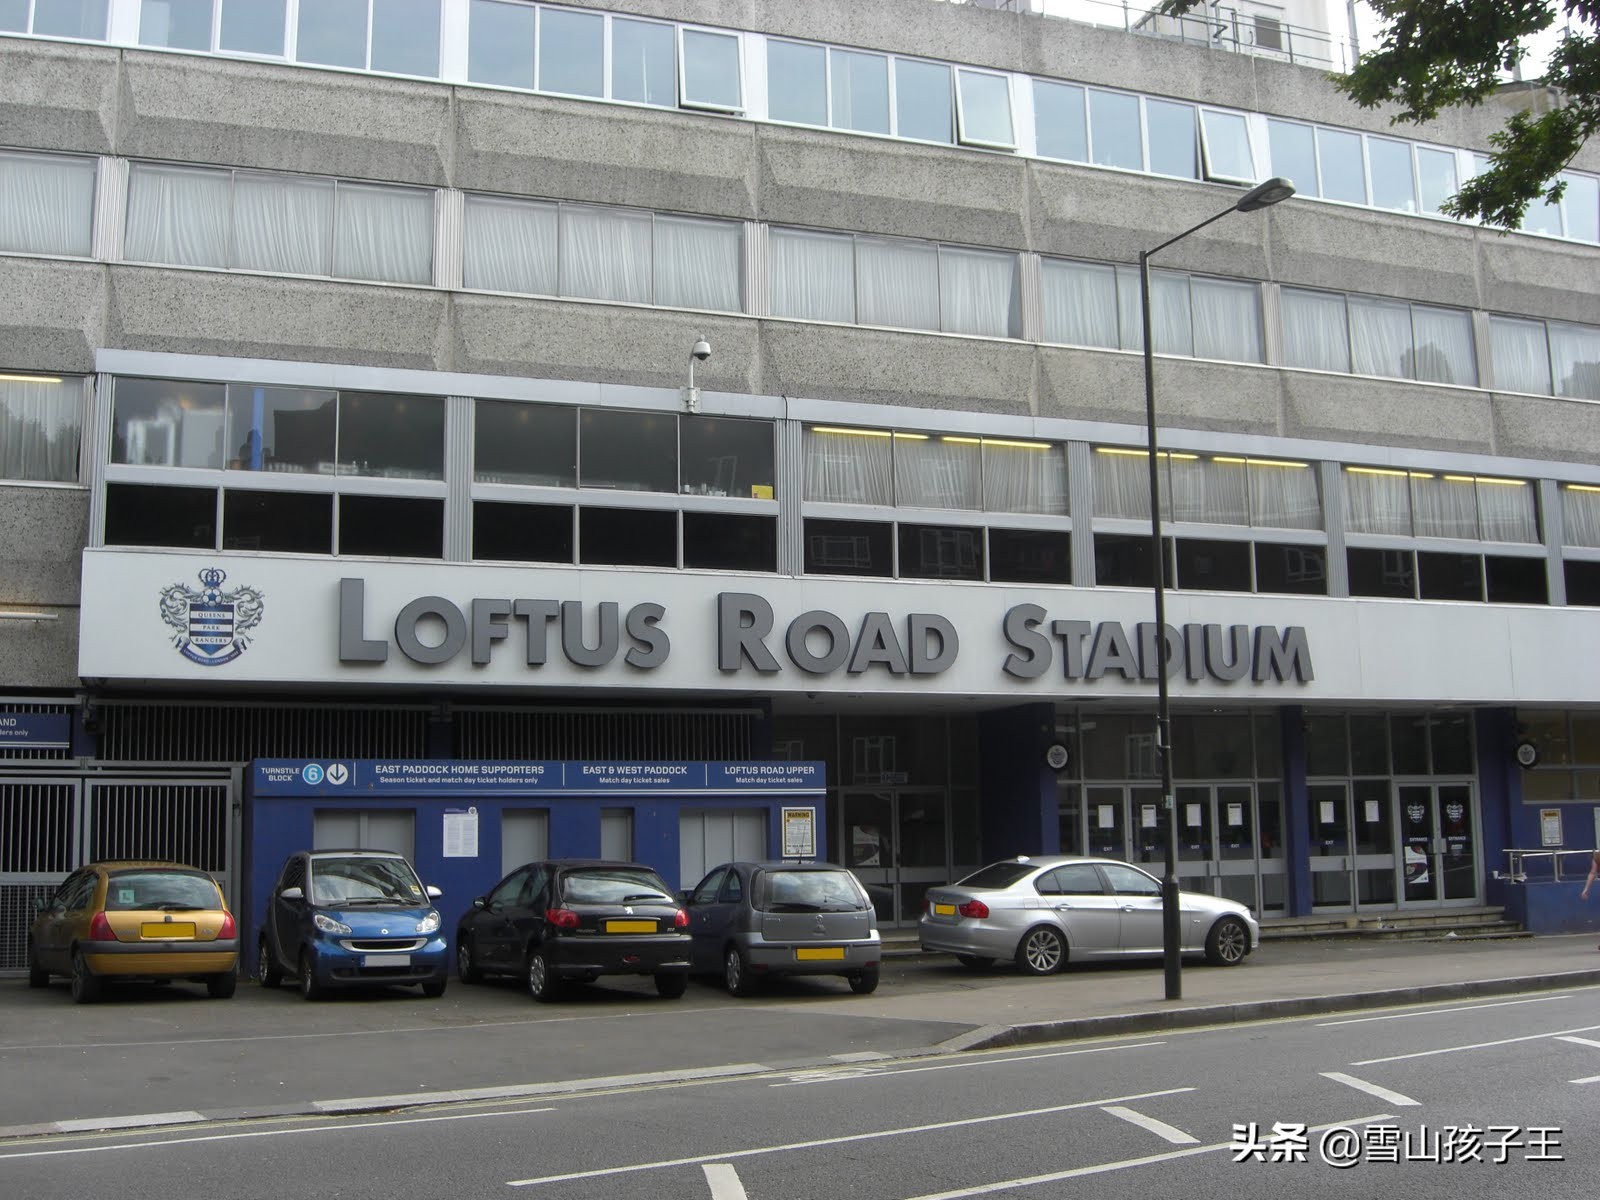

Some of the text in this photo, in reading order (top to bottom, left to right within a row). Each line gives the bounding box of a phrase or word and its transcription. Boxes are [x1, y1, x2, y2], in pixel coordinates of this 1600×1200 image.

[338, 576, 1315, 683] LOFTUS ROAD STADIUM
[14, 729, 29, 737] only
[261, 767, 300, 775] TURNSTILE
[308, 767, 318, 781] 6
[375, 764, 545, 775] EAST PADDOCK HOME SUPPORTERS
[582, 765, 688, 775] EAST & WEST PADDOCK
[724, 765, 815, 775] LOFTUS ROAD UPPER
[268, 774, 293, 782] BLOCK
[380, 776, 538, 785] Season ticket and match day ticket holders only
[620, 777, 632, 785] day
[735, 776, 804, 785] Match day ticket sales
[787, 811, 810, 819] WARNING
